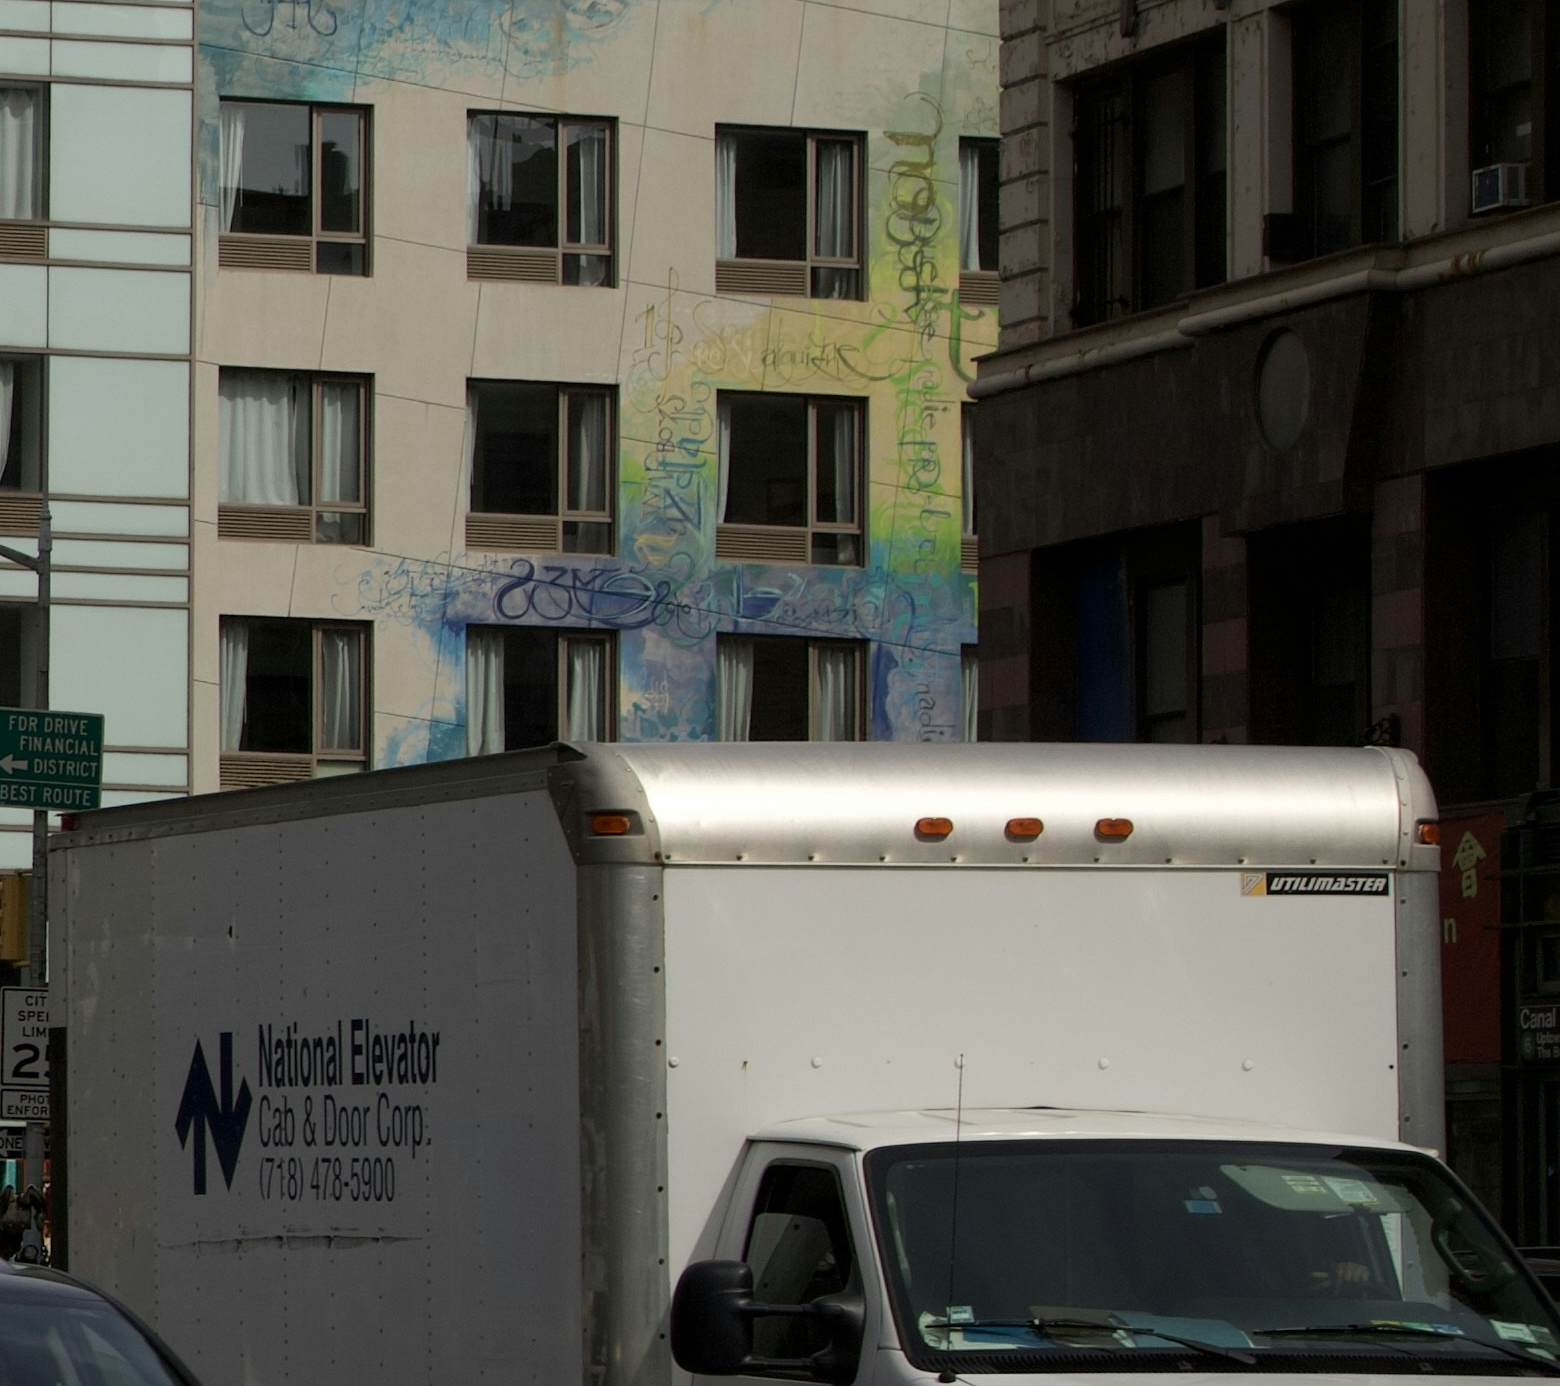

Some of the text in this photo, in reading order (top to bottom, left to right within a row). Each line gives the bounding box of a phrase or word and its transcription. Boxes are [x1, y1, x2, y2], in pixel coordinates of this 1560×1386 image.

[9, 715, 89, 736] FDR DRIVE
[19, 735, 100, 757] FINANCIAL
[33, 758, 100, 778] DISTRICT
[0, 783, 92, 808] BEST ROUTE
[24, 995, 48, 1007] CIT
[17, 1010, 49, 1023] SPE
[1519, 1006, 1558, 1030] Canal
[22, 1026, 47, 1038] LIM
[258, 1018, 440, 1088] National Elevator
[20, 1094, 50, 1105] PHO
[7, 1105, 49, 1116] ENFOR
[259, 1095, 296, 1148] Cab
[303, 1095, 318, 1147] &
[324, 1094, 371, 1148] Door
[259, 1156, 396, 1203] (718) 478-5900
